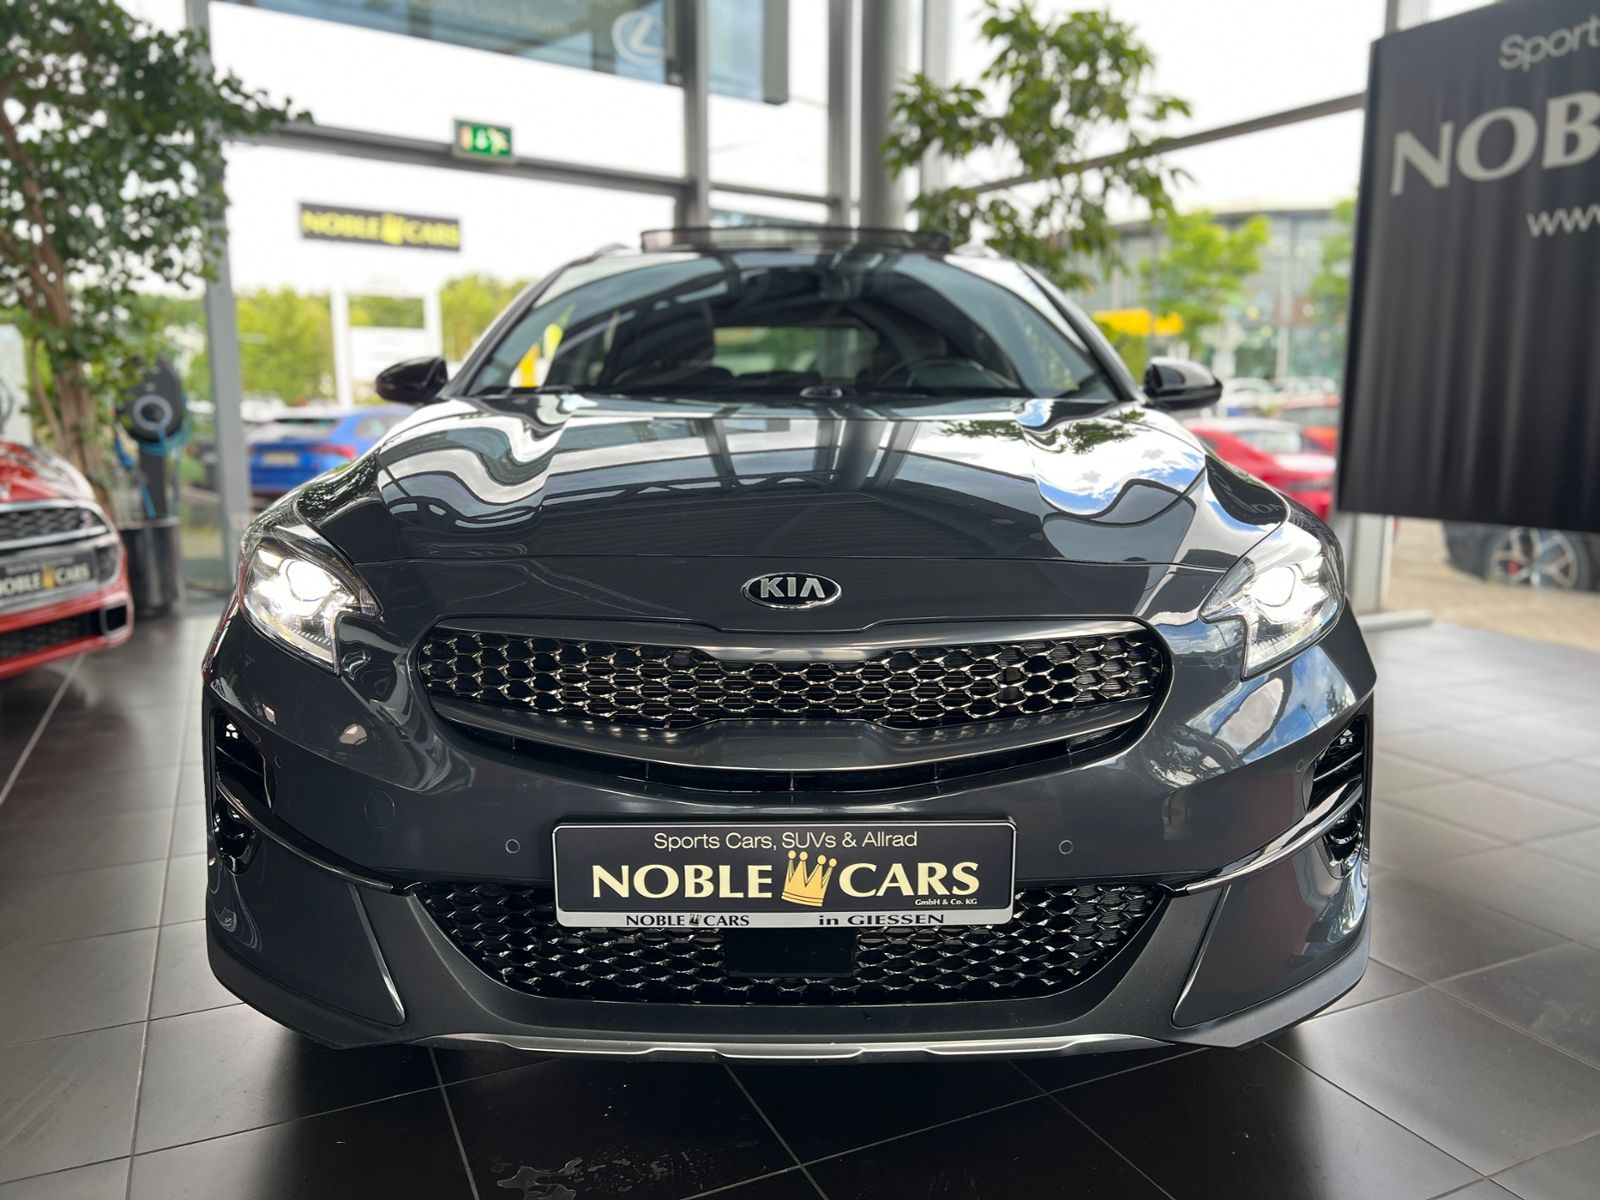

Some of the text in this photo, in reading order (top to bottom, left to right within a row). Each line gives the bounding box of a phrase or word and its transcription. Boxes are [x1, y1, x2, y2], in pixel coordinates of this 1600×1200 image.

[302, 210, 459, 247] NOBLE CARS
[760, 577, 826, 598] KIA
[654, 831, 918, 852] Sports Cars, SUVs & Allrad
[592, 861, 980, 899] NOBLE CARS
[626, 914, 750, 927] NOBLE CARS
[819, 913, 945, 926] in GIESSEN
